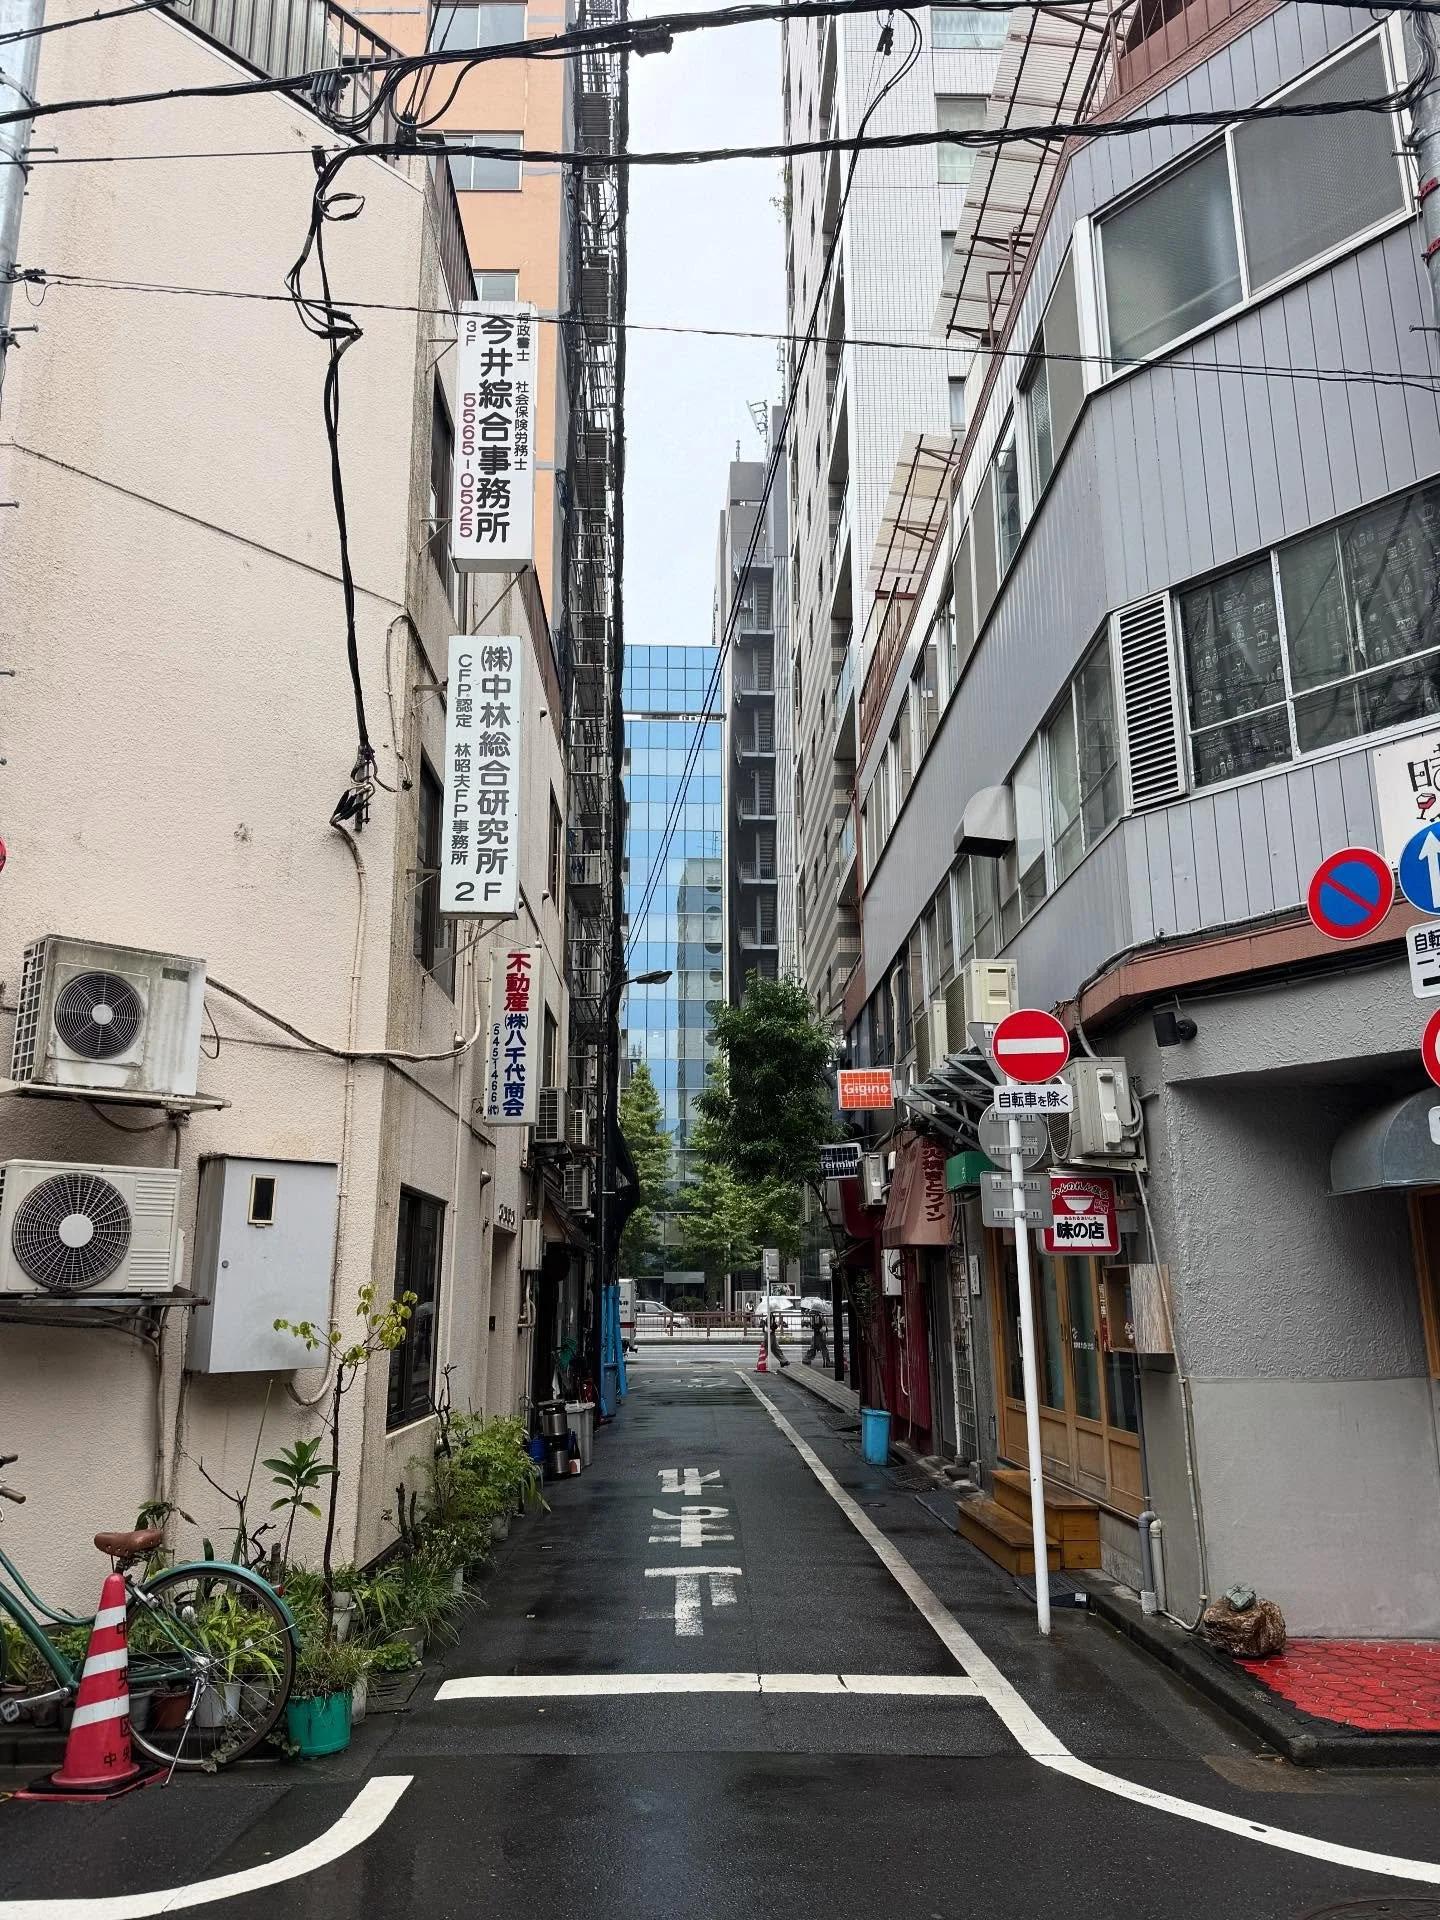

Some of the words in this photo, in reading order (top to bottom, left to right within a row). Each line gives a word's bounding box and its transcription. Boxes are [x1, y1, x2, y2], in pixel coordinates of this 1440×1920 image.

[465, 320, 478, 347] 3F
[516, 312, 531, 363] 行政書士
[475, 315, 515, 543] 今井綜合事務所
[513, 380, 530, 471] 社会保険労務士
[459, 392, 477, 538] 5565-0525
[475, 645, 513, 875] (株)中林総合研究所
[450, 742, 472, 866] 林昭夫FP事務所
[503, 952, 532, 1013] 不動産
[502, 1012, 529, 1117] (株)八千代商会
[843, 1082, 889, 1096] Gigino
[998, 1091, 1069, 1109] 自転車を除く
[1056, 1221, 1105, 1240] 味の店
